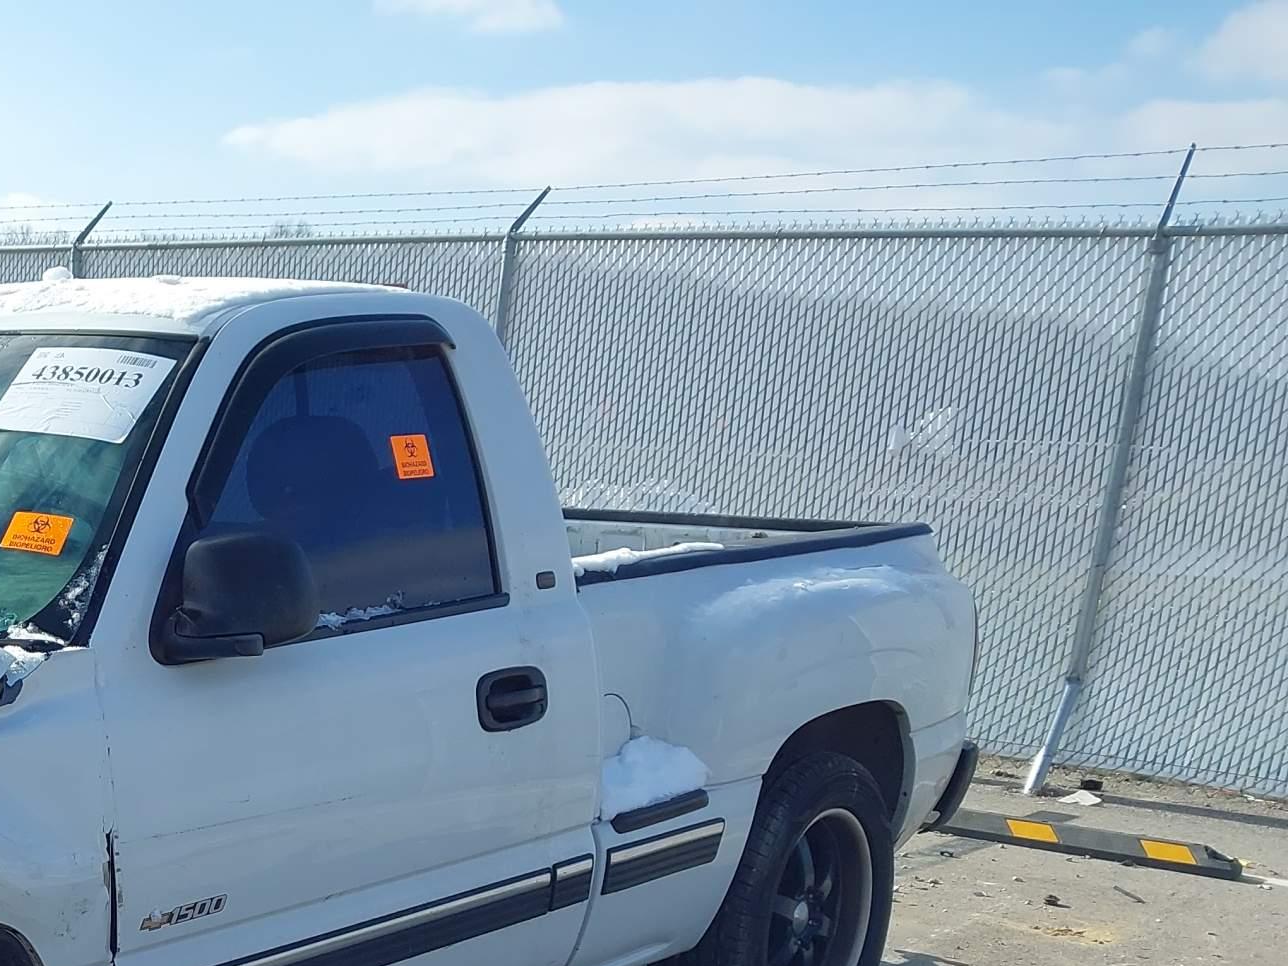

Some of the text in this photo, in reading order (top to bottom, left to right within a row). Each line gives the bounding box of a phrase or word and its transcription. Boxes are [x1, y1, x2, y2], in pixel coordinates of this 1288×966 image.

[31, 364, 144, 389] 43850013
[12, 534, 56, 545] BIOHAZARD
[170, 893, 228, 926] 1500
